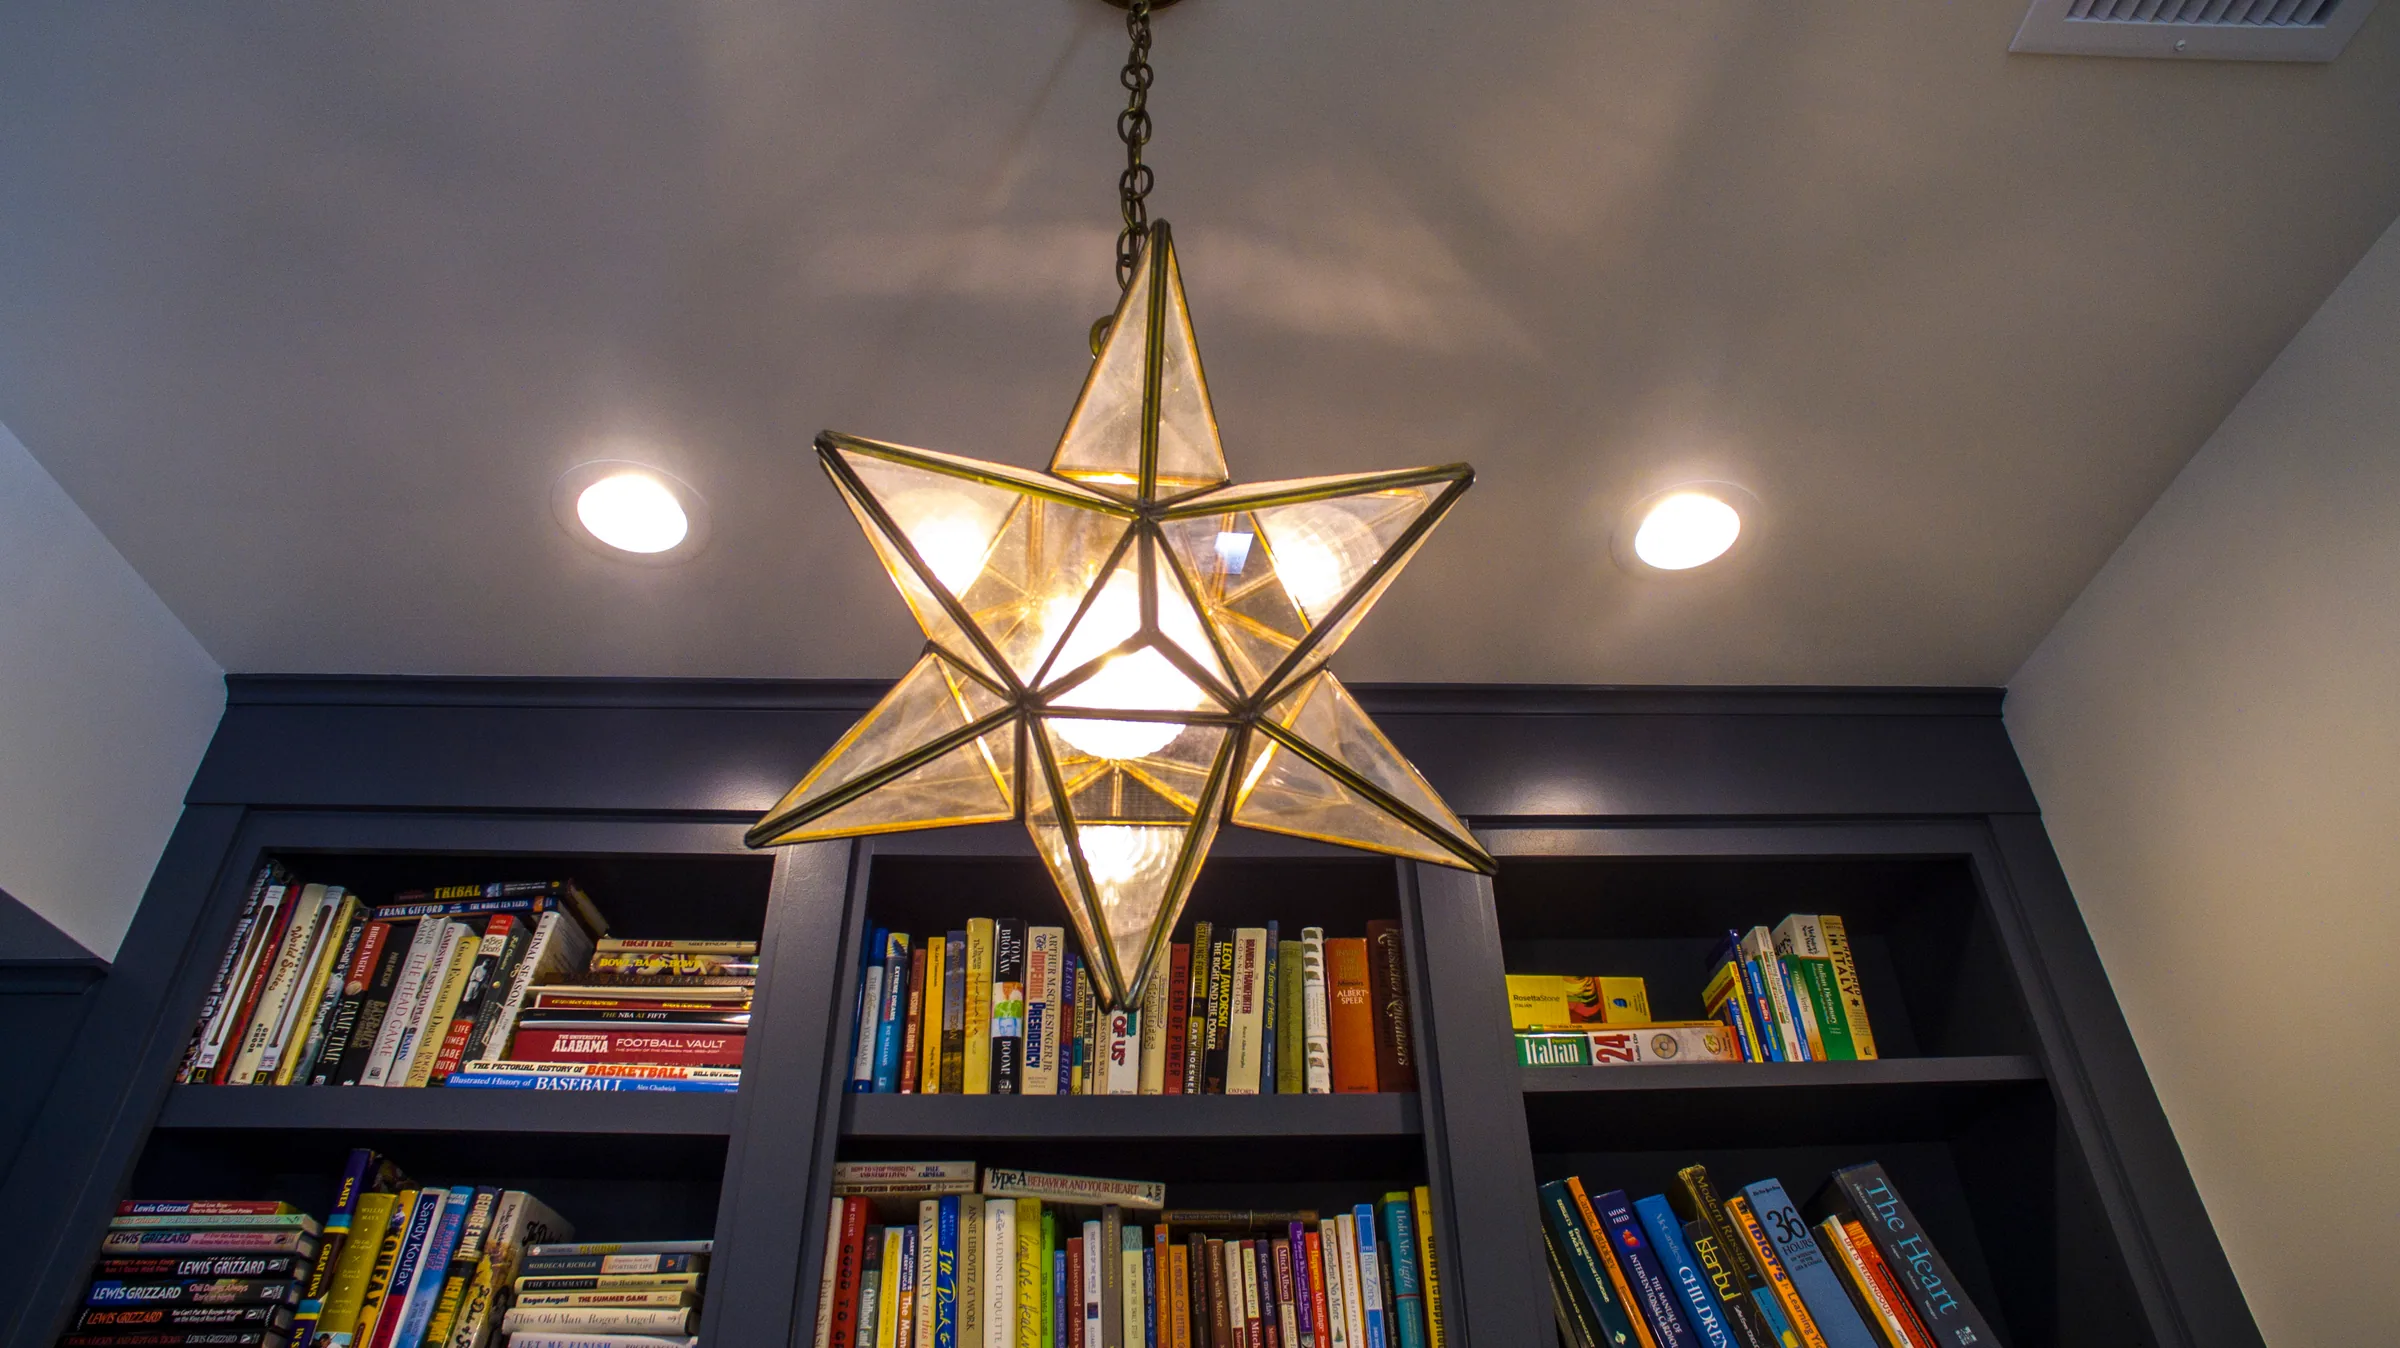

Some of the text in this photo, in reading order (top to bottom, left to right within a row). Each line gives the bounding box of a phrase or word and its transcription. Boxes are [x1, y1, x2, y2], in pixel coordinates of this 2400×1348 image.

[434, 886, 481, 899] TRIBAL
[379, 905, 405, 917] FRANK
[408, 904, 443, 915] GIFFORD
[999, 929, 1011, 974] BROKAW
[1010, 939, 1019, 963] TOM
[1828, 934, 1854, 995] IN ITALY
[507, 932, 545, 1007] FINAL SEASON
[1063, 959, 1073, 999] REASON
[1211, 958, 1220, 980] RIGHT
[1215, 942, 1233, 1026] LEON JAWORSKI
[1842, 944, 1861, 996] HAPPENED
[380, 952, 427, 1057] THE HEAD GAME
[909, 991, 918, 1015] WISDOM
[1210, 982, 1219, 1000] AND
[1817, 963, 1838, 1024] Italian Dictionary
[1168, 965, 1184, 1076] THE END OF POWER
[1209, 1001, 1217, 1017] THE
[445, 1035, 464, 1046] TIMES
[454, 1024, 470, 1034] LIFE
[616, 1038, 726, 1049] FOOTBALL VAULT
[905, 1023, 915, 1051] SOLOMON
[1025, 1002, 1045, 1068] PRESIDENCY
[1207, 1018, 1216, 1049] POWER
[398, 1034, 412, 1060] KAHN
[440, 1049, 460, 1059] BABE
[552, 1040, 608, 1052] ALABAMA
[1000, 1040, 1011, 1074] BOOM!
[1187, 1021, 1198, 1093] GARY NOESNER
[1524, 1039, 1579, 1065] Italian
[1594, 1034, 1633, 1063] 24
[435, 1061, 455, 1071] RUTH
[491, 1063, 534, 1071] PICTORIAL
[537, 1064, 571, 1072] HISTORY
[586, 1065, 688, 1079] BASKETBALL
[1059, 1049, 1069, 1084] REICH
[450, 1076, 626, 1092] Illustrated History of BASEBALL
[338, 1177, 354, 1207] SLATER
[988, 1168, 1016, 1190] Type
[1016, 1171, 1027, 1185] A
[1027, 1174, 1067, 1189] BEHAVIOR
[1069, 1179, 1088, 1191] AND
[1087, 1181, 1110, 1192] YOUR
[1111, 1182, 1139, 1195] HEART
[156, 1204, 189, 1212] Grizzard
[410, 1201, 434, 1241] Sandy
[847, 1213, 855, 1236] COLLINS
[1697, 1176, 1750, 1271] Modern Russian
[110, 1233, 190, 1243] LEWIS GRIZZARD
[1578, 1194, 1617, 1270] Cardiac Pathology
[1655, 1213, 1682, 1264] McCandless
[1766, 1206, 1806, 1244] 36
[1846, 1220, 1872, 1249] NUTS!
[921, 1216, 932, 1298] ANN ROMNEY
[1211, 1245, 1220, 1277] tuesdays
[1395, 1209, 1414, 1288] Hold Me Tight
[1781, 1238, 1815, 1255] HOURS
[1865, 1177, 1958, 1315] The Heart
[177, 1259, 265, 1275] LEWIS GRIZZARD
[363, 1228, 400, 1308] KOUFAX
[396, 1243, 422, 1286] Koufax
[966, 1205, 976, 1330] ANNIE LEIBOVITZ AT WORK
[1070, 1252, 1081, 1306] undiscovered
[1278, 1248, 1291, 1299] Mitch Albom
[1323, 1227, 1341, 1319] Codependent No More
[1695, 1236, 1741, 1301] Istanbul
[1748, 1223, 1814, 1335] IDIOT'S Learning
[1844, 1238, 1893, 1317] LIFE IS TREMENDOUS!
[92, 1287, 181, 1299] LEWIS GRIZZARD
[294, 1244, 331, 1340] GREAT JEWS IN
[547, 1279, 593, 1287] TEAMMATES
[993, 1232, 1003, 1343] WEDDING ETIQUETTE
[1260, 1252, 1268, 1263] for
[1264, 1302, 1272, 1316] day
[1629, 1254, 1663, 1316] INTERVENTIONAL
[87, 1311, 162, 1324] LEWIS GRIZZARD
[513, 1313, 581, 1324] This Old Man
[588, 1313, 655, 1324] Roger Angell
[857, 1287, 876, 1346] Childhood and
[921, 1305, 930, 1338] in this
[1215, 1300, 1224, 1327] Morrie
[1650, 1276, 1682, 1334] THE MANUAL OF
[186, 1334, 237, 1343] LEWIS GRIZZARD
